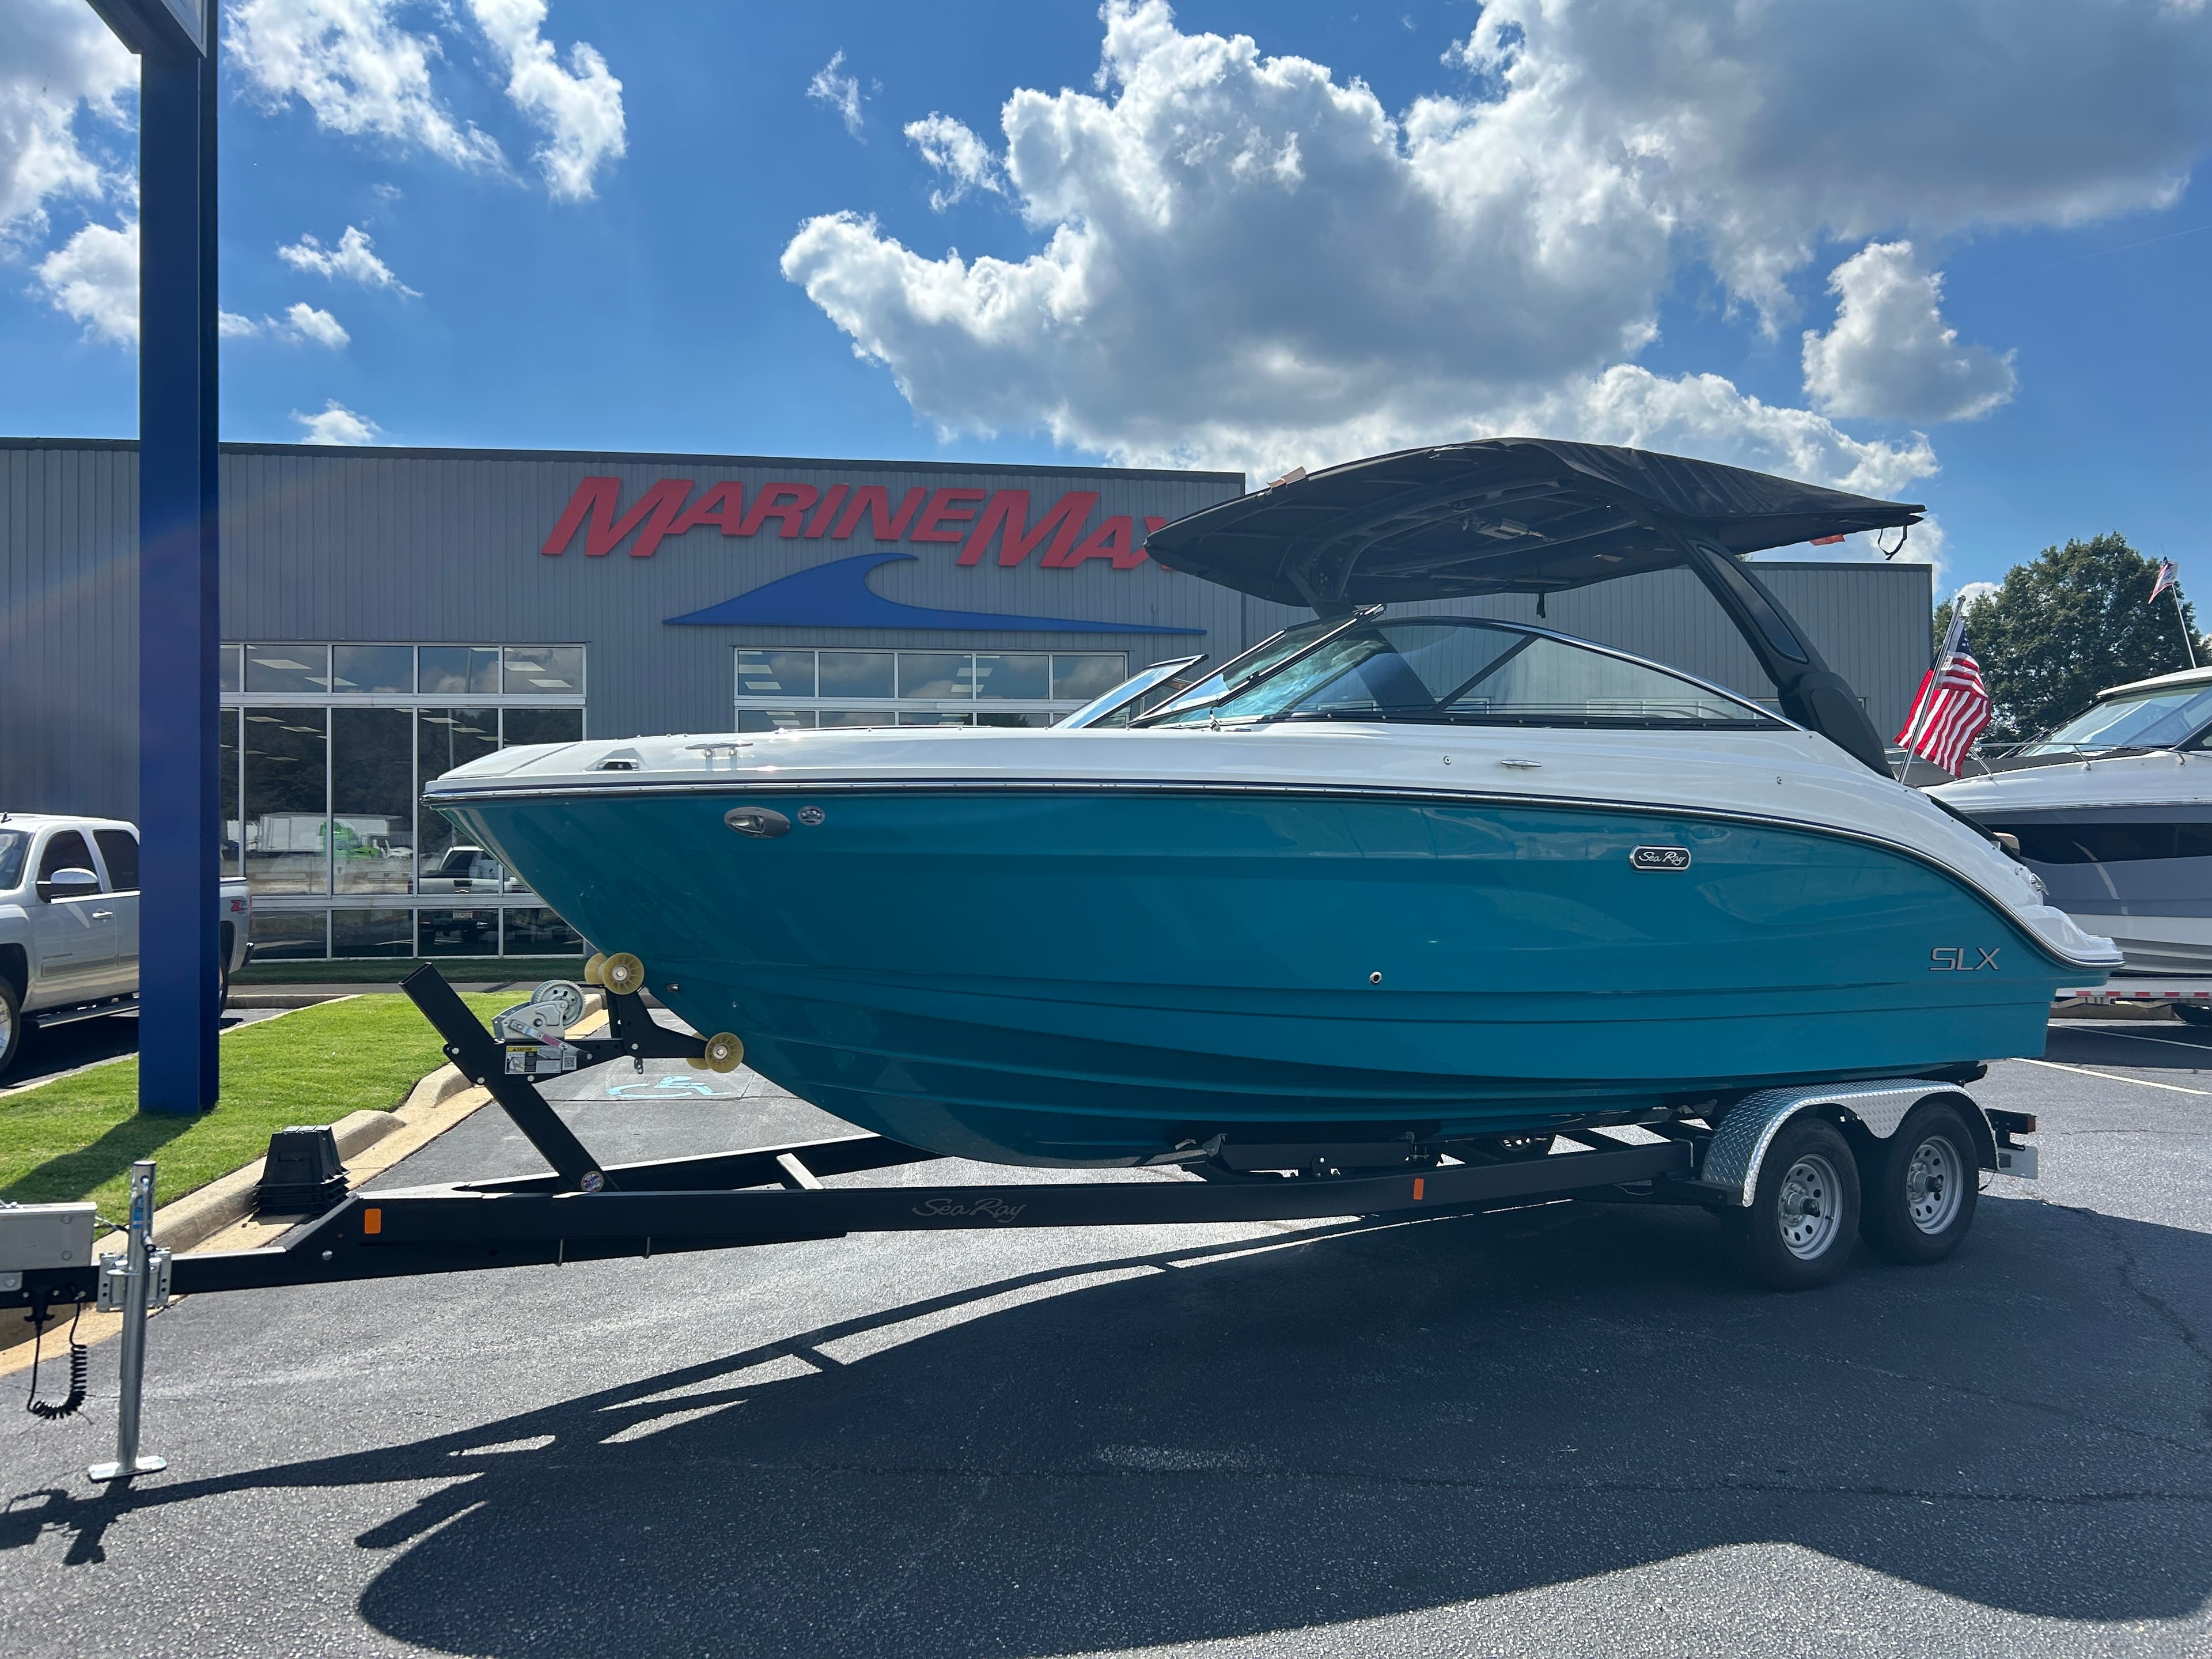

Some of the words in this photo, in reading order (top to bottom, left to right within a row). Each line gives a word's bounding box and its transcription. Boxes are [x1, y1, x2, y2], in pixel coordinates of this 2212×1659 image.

[1638, 851, 1662, 862] Sea
[1662, 851, 1686, 866] Ray
[1929, 947, 2001, 971] SLX
[912, 1198, 971, 1216] Sea
[969, 1198, 1027, 1223] Ray
